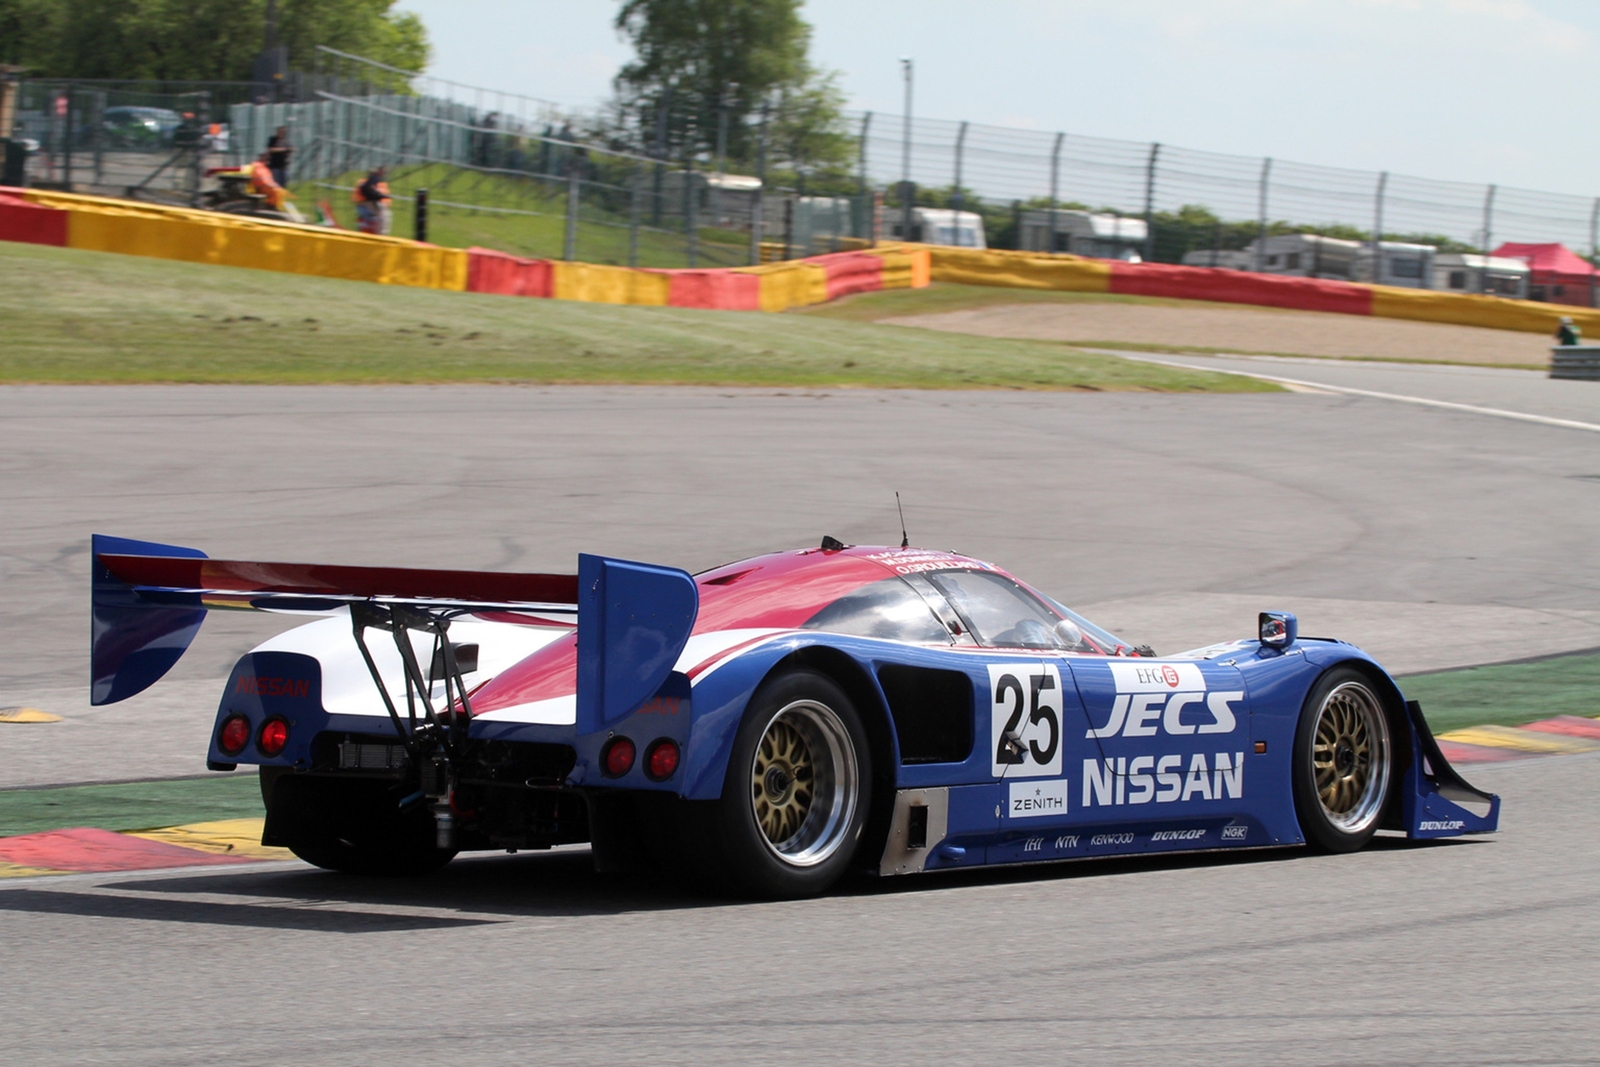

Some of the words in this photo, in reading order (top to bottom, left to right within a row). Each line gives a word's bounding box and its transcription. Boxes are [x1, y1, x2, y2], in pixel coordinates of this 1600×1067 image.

[1136, 668, 1164, 684] EFG
[235, 675, 311, 698] NISSAN
[995, 673, 1059, 766] 25
[1085, 691, 1244, 739] JECS
[1082, 752, 1244, 807] NISSAN
[1013, 797, 1063, 811] ZENITH
[1223, 828, 1245, 837] NGK
[1419, 820, 1464, 831] DUNLOP
[1055, 835, 1080, 849] NTN
[1090, 832, 1135, 846] KENWOOD
[1151, 829, 1207, 841] DUNLOP
[1024, 837, 1045, 852] IHI
